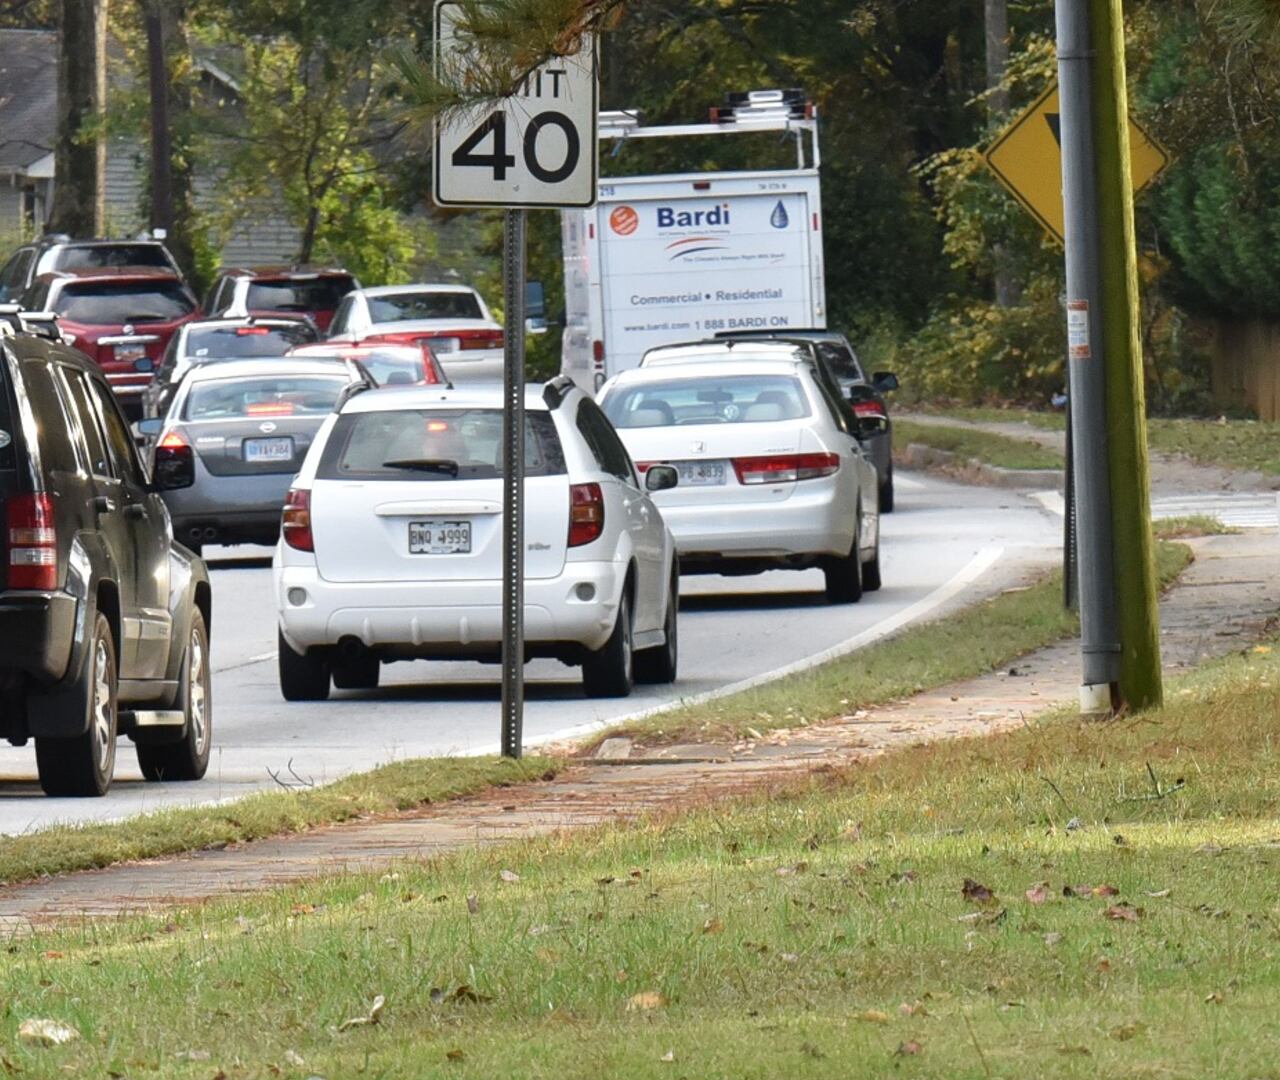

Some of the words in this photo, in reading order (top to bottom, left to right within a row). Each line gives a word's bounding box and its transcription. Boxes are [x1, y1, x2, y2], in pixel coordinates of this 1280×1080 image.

[452, 110, 580, 183] 40
[656, 203, 731, 228] Bardi
[630, 292, 703, 306] Commercial
[715, 289, 783, 302] Residential
[624, 321, 690, 332] www.bardi.com
[704, 319, 725, 331] 888
[728, 317, 767, 329] BARDI
[770, 315, 789, 327] ON
